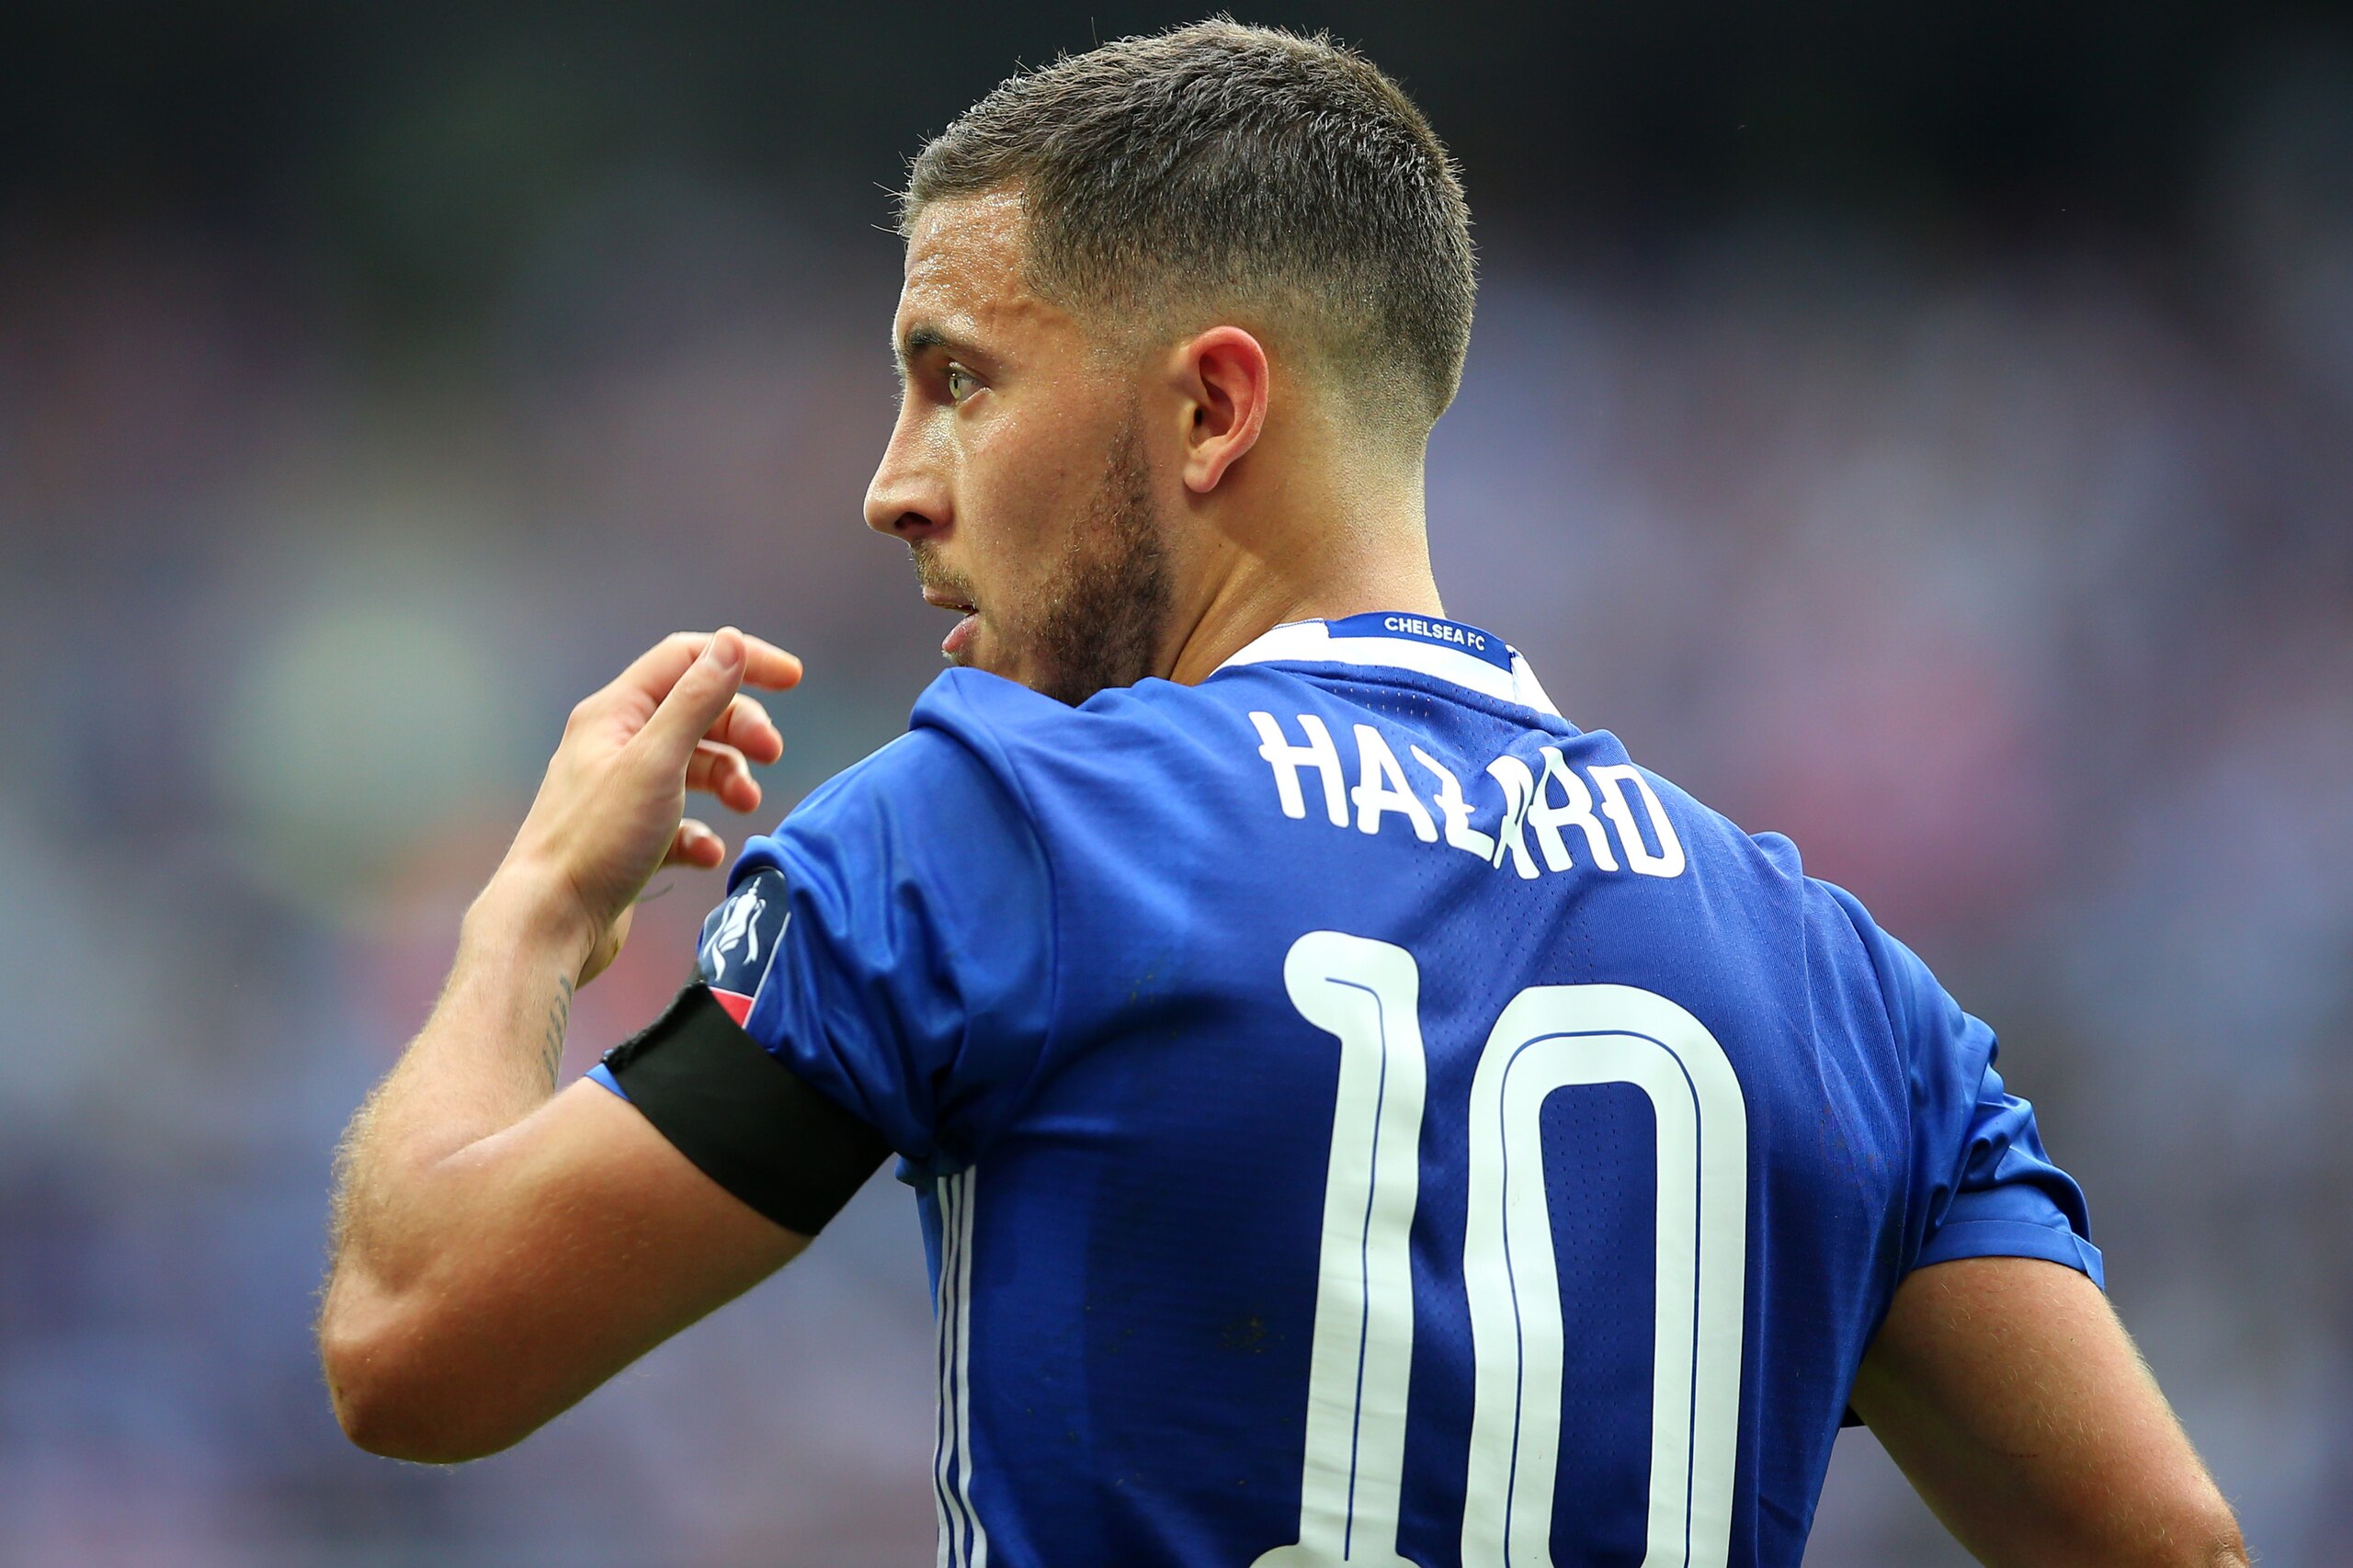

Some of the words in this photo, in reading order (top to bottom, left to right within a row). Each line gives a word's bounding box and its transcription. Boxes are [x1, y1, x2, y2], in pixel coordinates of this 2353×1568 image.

[1383, 617, 1465, 645] CHELSEA
[1467, 631, 1485, 652] FC
[1248, 710, 1687, 881] HAZARD
[1248, 929, 1747, 1568] 10
